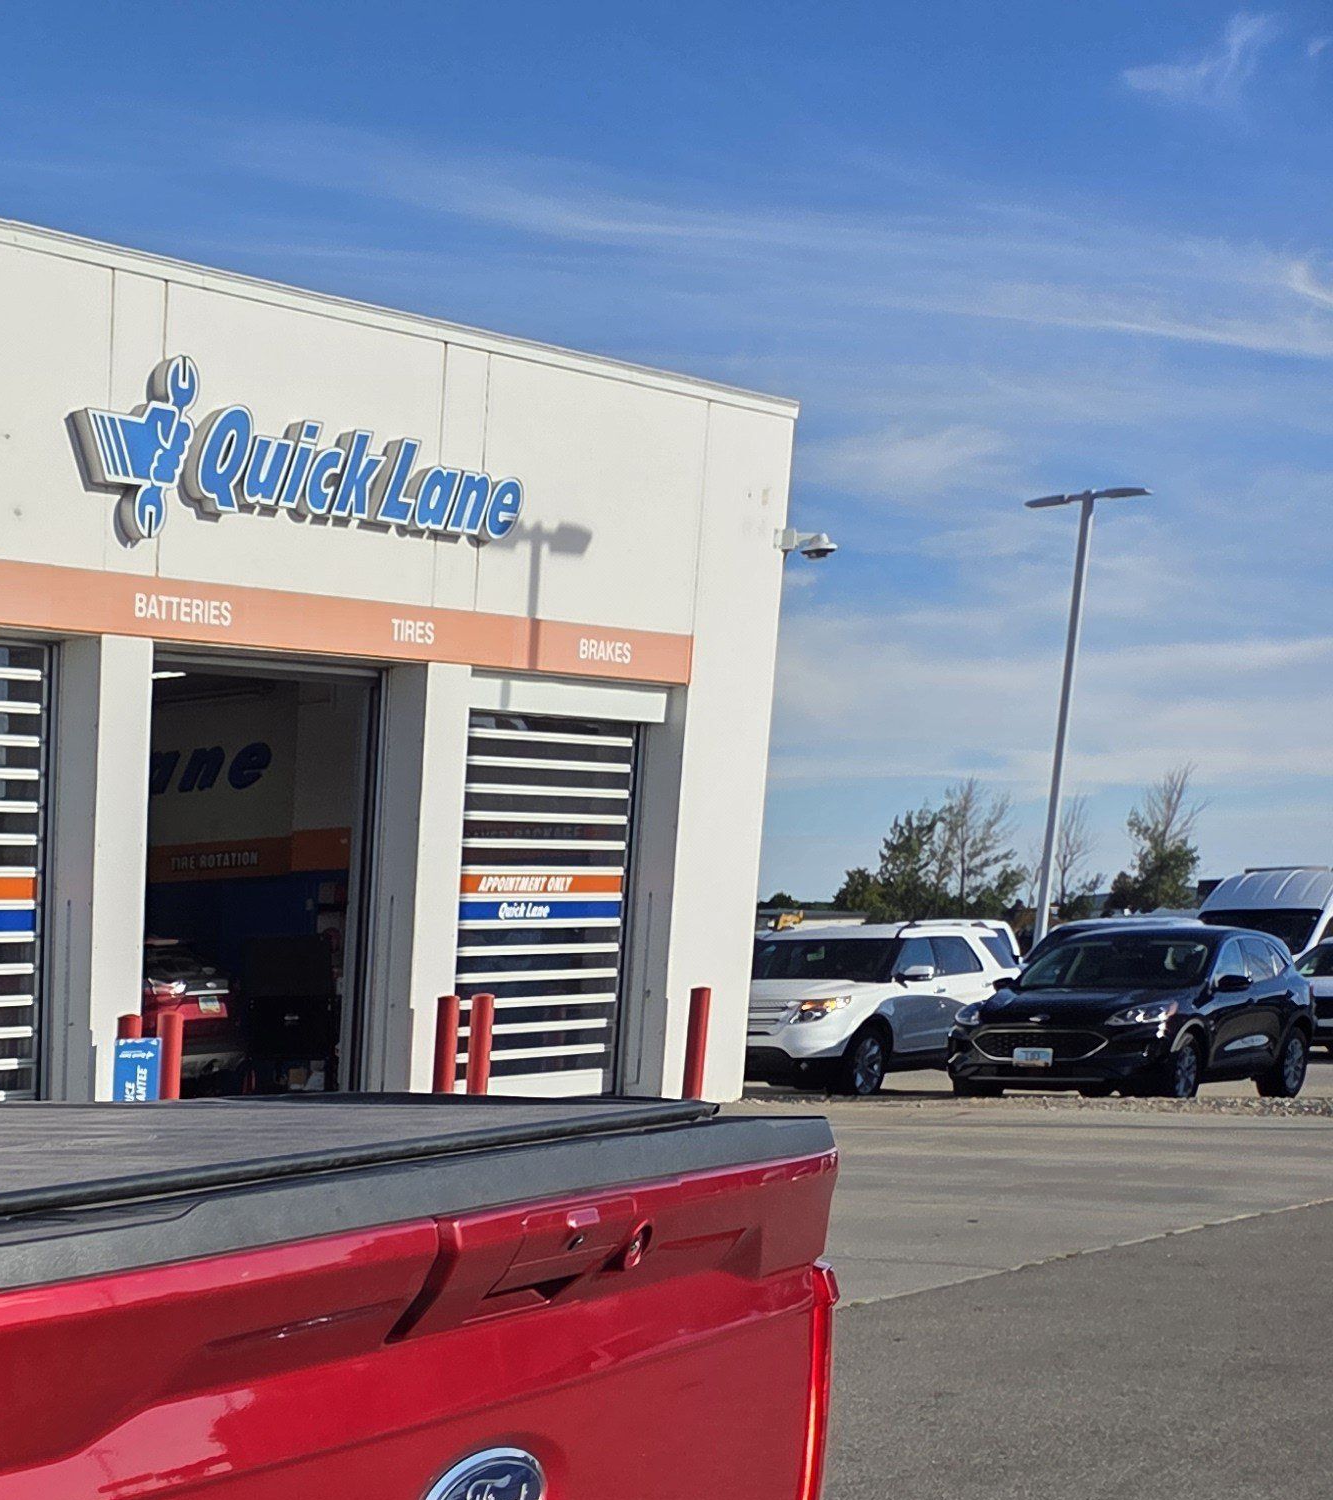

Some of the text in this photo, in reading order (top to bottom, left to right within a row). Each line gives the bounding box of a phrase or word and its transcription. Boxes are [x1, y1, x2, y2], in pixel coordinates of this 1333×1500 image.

[198, 404, 524, 540] Quick Lane
[133, 592, 232, 627] BATTERIES
[390, 618, 435, 645] TIRES
[579, 638, 632, 664] BRAKES
[171, 851, 259, 871] TIRE ROTATION
[477, 876, 574, 892] APPOINTMENT ONLY
[498, 902, 551, 920] Quick Lane
